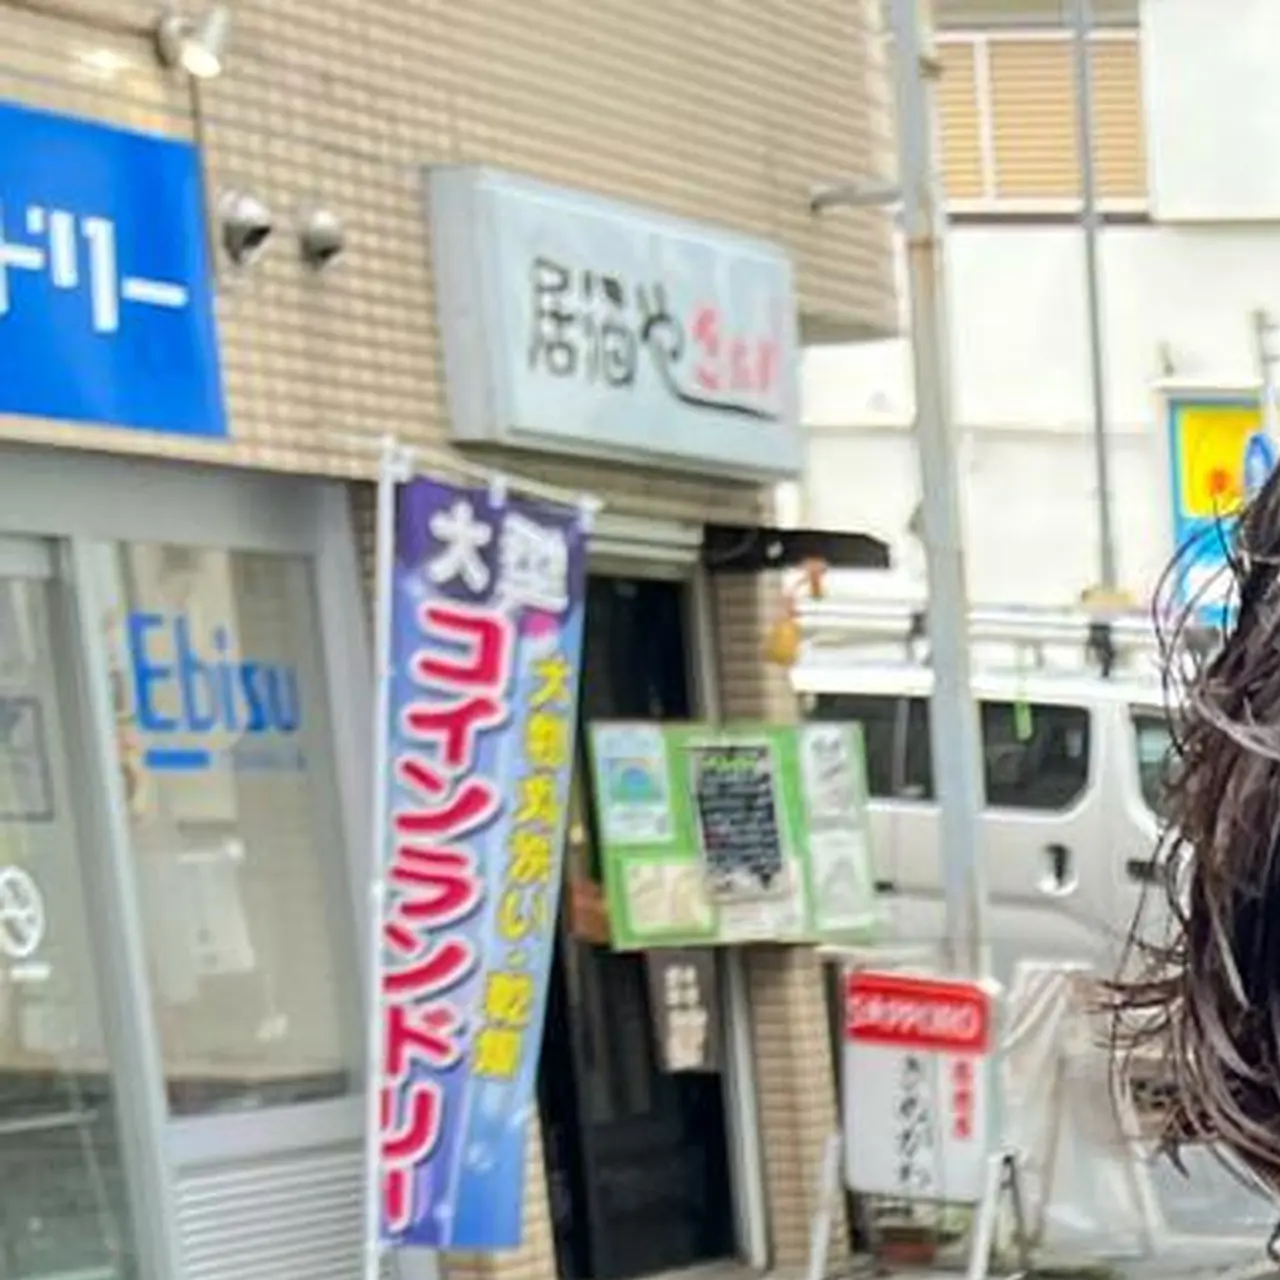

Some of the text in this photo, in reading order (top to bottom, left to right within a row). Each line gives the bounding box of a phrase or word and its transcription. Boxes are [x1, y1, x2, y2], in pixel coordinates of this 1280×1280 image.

[126, 613, 302, 733] Ebisu
[379, 604, 509, 1229] コインランドリー
